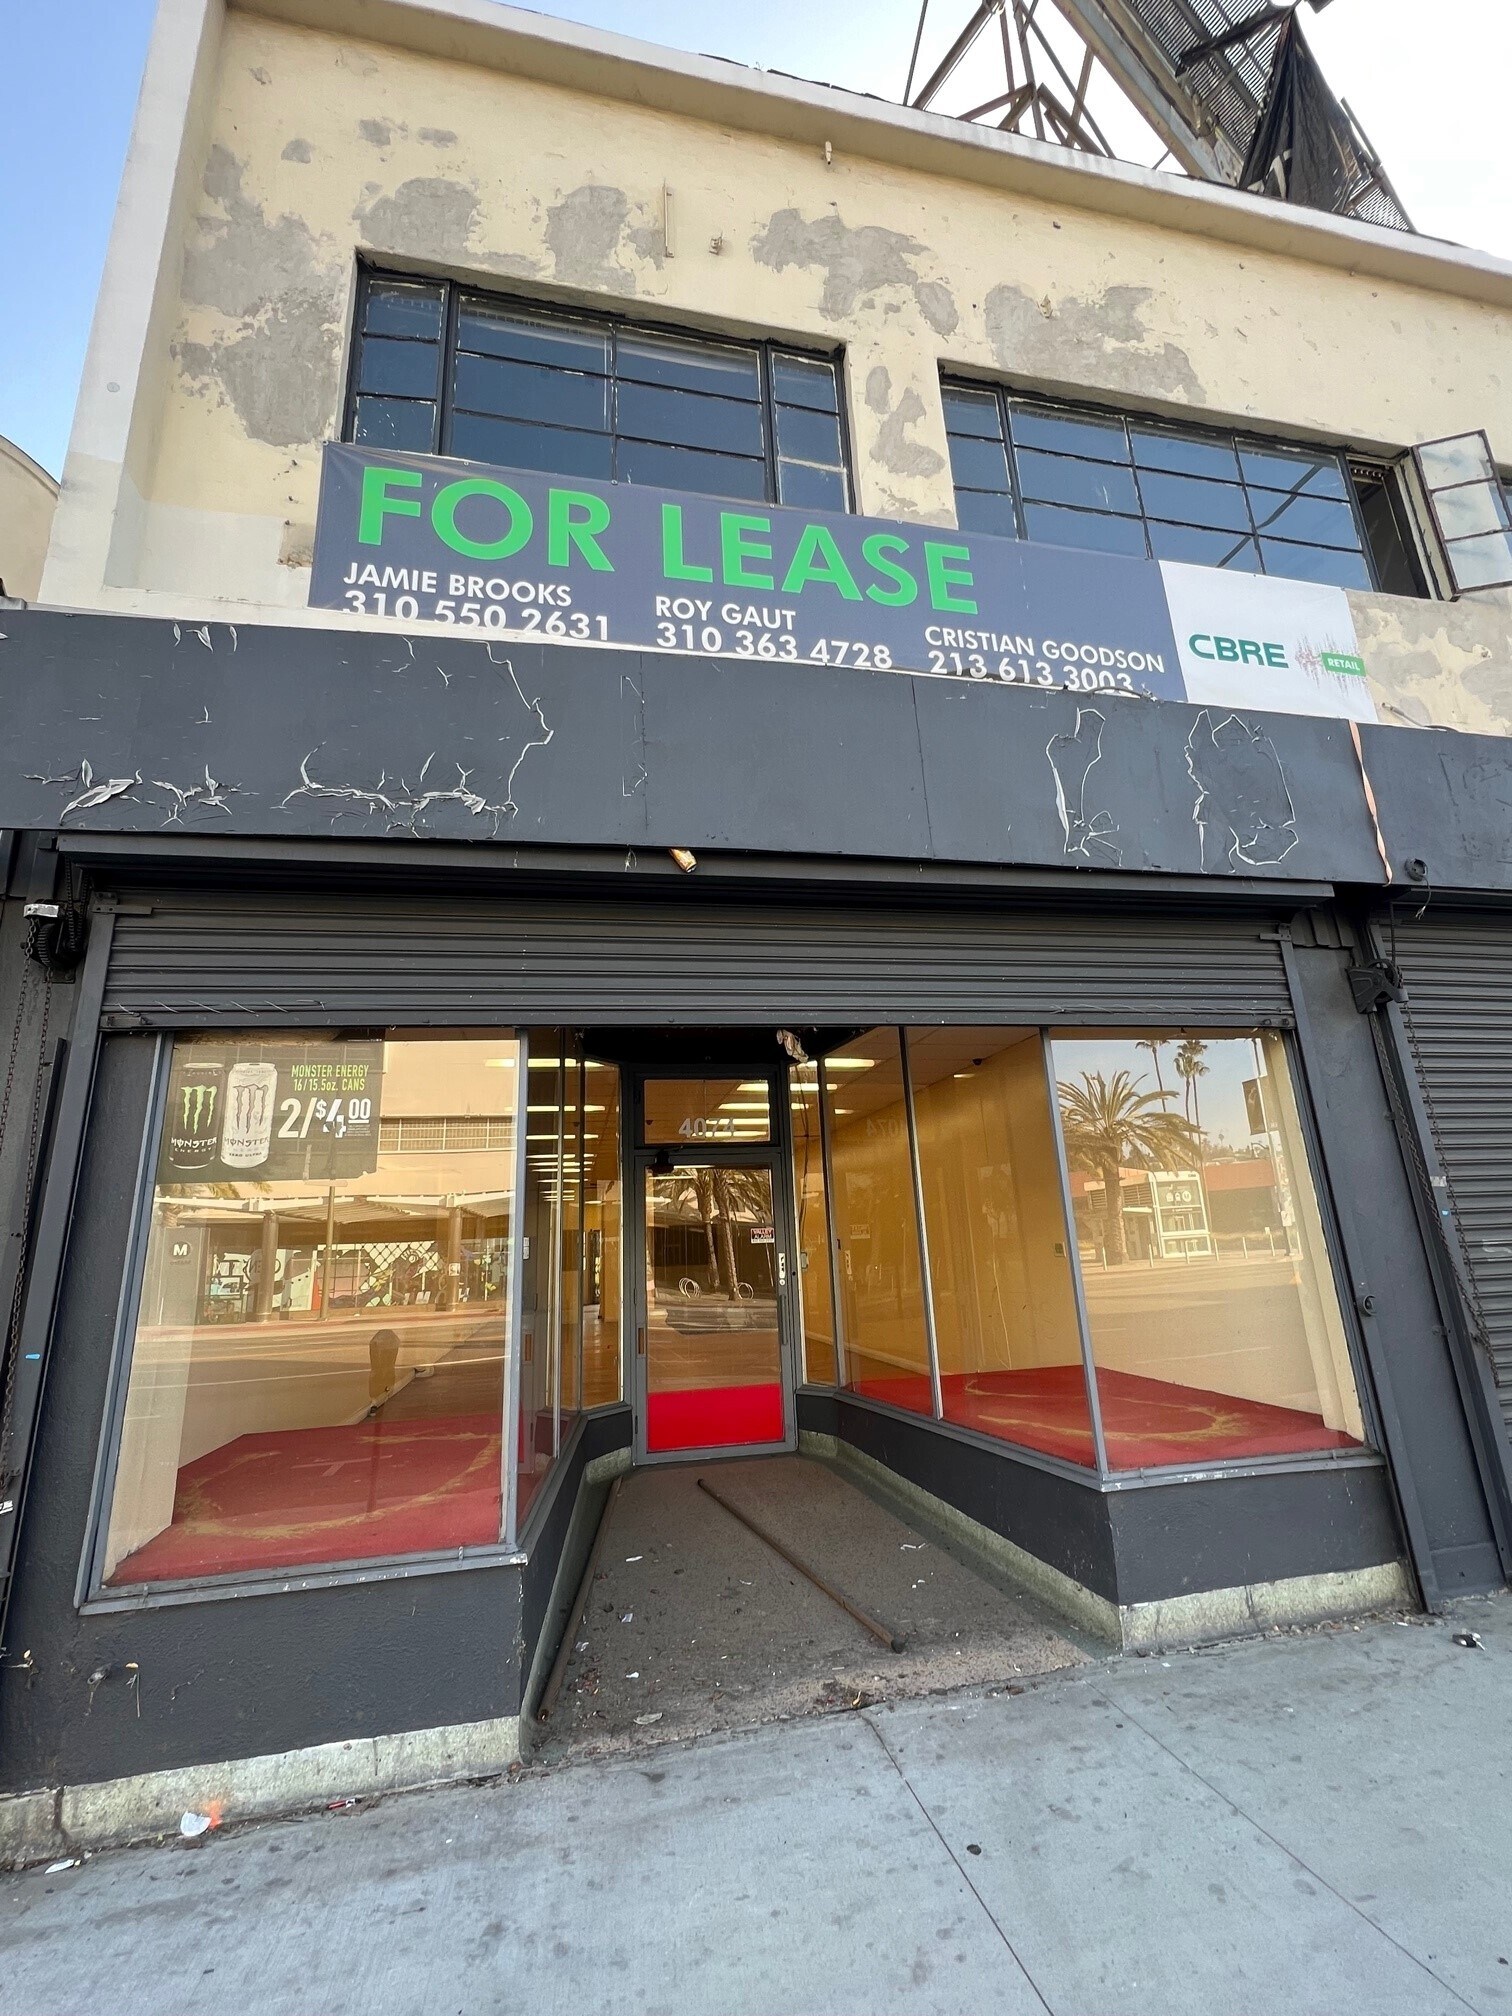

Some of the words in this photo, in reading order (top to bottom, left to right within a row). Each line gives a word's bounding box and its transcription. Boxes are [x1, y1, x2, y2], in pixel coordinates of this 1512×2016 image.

[358, 466, 615, 572] FOR
[662, 503, 978, 615] LEASE
[343, 562, 438, 593] JAMIE
[449, 574, 572, 607] BROOKS
[343, 590, 419, 621] 310
[434, 600, 507, 630] 550
[520, 608, 609, 641] 2631
[655, 596, 713, 621] ROY
[721, 604, 796, 631] GAUT
[656, 622, 722, 652] 310
[735, 630, 798, 660] 363
[810, 638, 893, 669] 4728
[924, 626, 1035, 656] CRISTIAN
[1042, 640, 1165, 673] GOODSON
[1188, 633, 1290, 669] CBRE
[928, 650, 988, 678] 213
[999, 657, 1054, 686] 613
[1327, 657, 1361, 672] RETAIL
[291, 1064, 333, 1078] MONSTER
[335, 1064, 369, 1078] ENERGY
[341, 1078, 365, 1091] CANS
[171, 1136, 217, 1149] MONSTER
[224, 1136, 269, 1149] MONSTER
[678, 1117, 735, 1139] 4074
